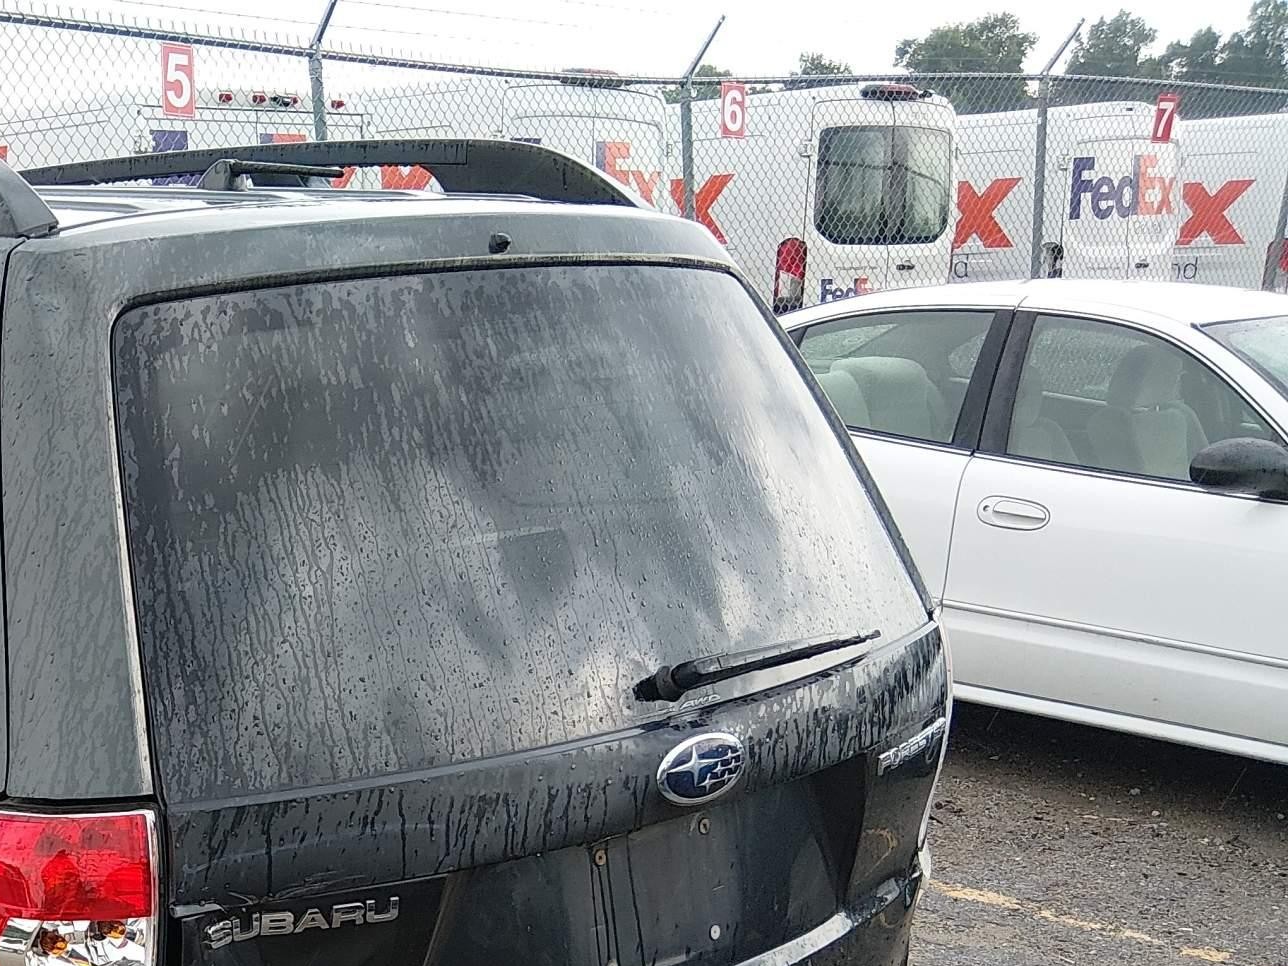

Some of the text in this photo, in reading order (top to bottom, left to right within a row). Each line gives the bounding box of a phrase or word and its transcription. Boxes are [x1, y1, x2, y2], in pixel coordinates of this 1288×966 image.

[166, 52, 191, 108] 5
[723, 89, 743, 132] 6
[1156, 102, 1175, 138] 7
[1069, 154, 1176, 220] FedEx
[203, 896, 400, 949] SUBARU
